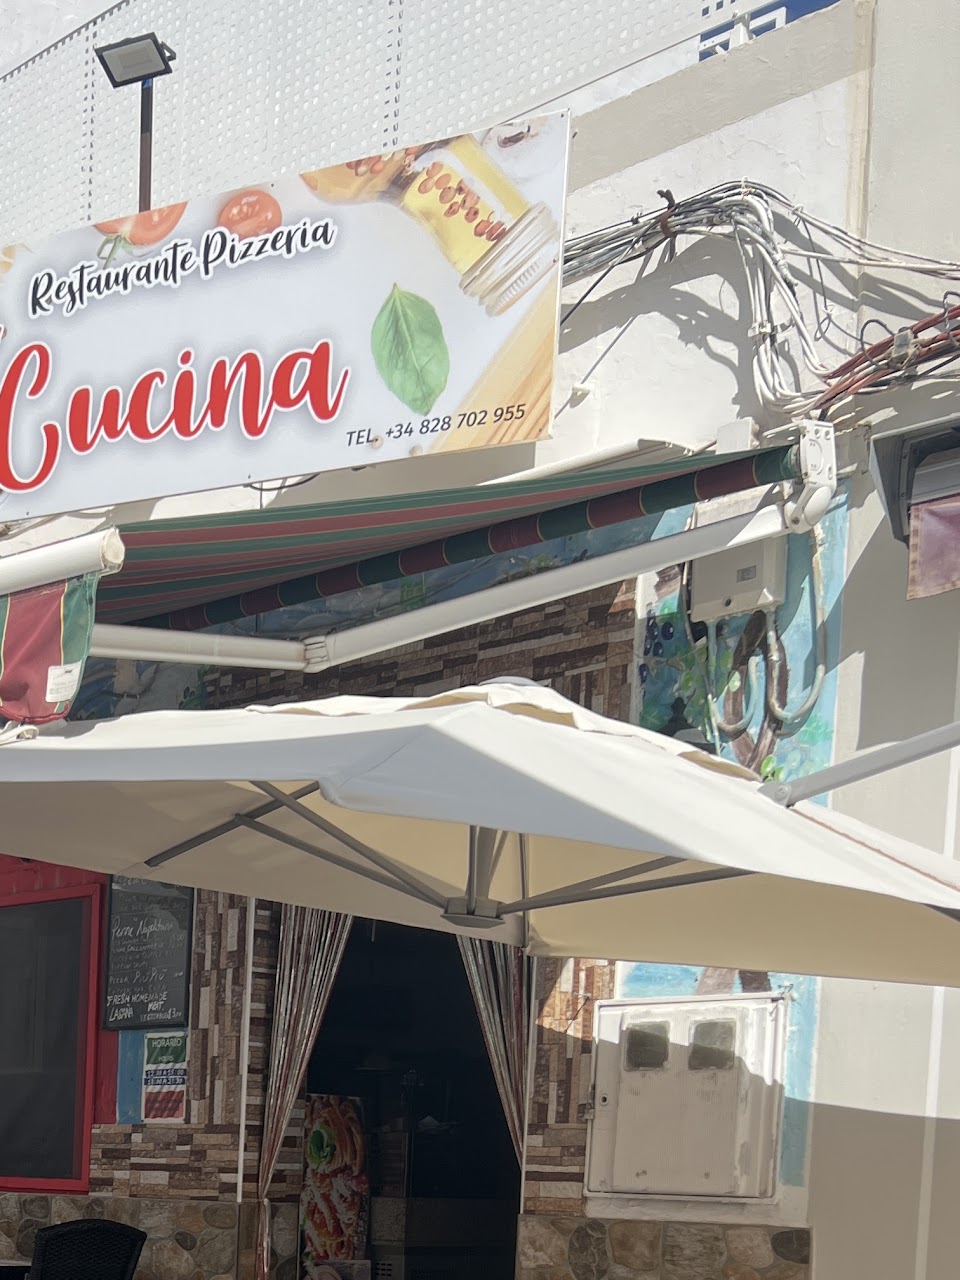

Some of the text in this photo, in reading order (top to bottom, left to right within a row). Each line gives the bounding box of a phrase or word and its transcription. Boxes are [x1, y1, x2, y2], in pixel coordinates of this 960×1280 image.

[30, 221, 335, 315] Restaurante Pizzeria
[347, 404, 527, 447] TEL. +34 828 702 955
[109, 975, 129, 985] PIZZA
[107, 991, 168, 1007] FRESH HOMEMADE
[152, 1038, 183, 1048] HORARIO
